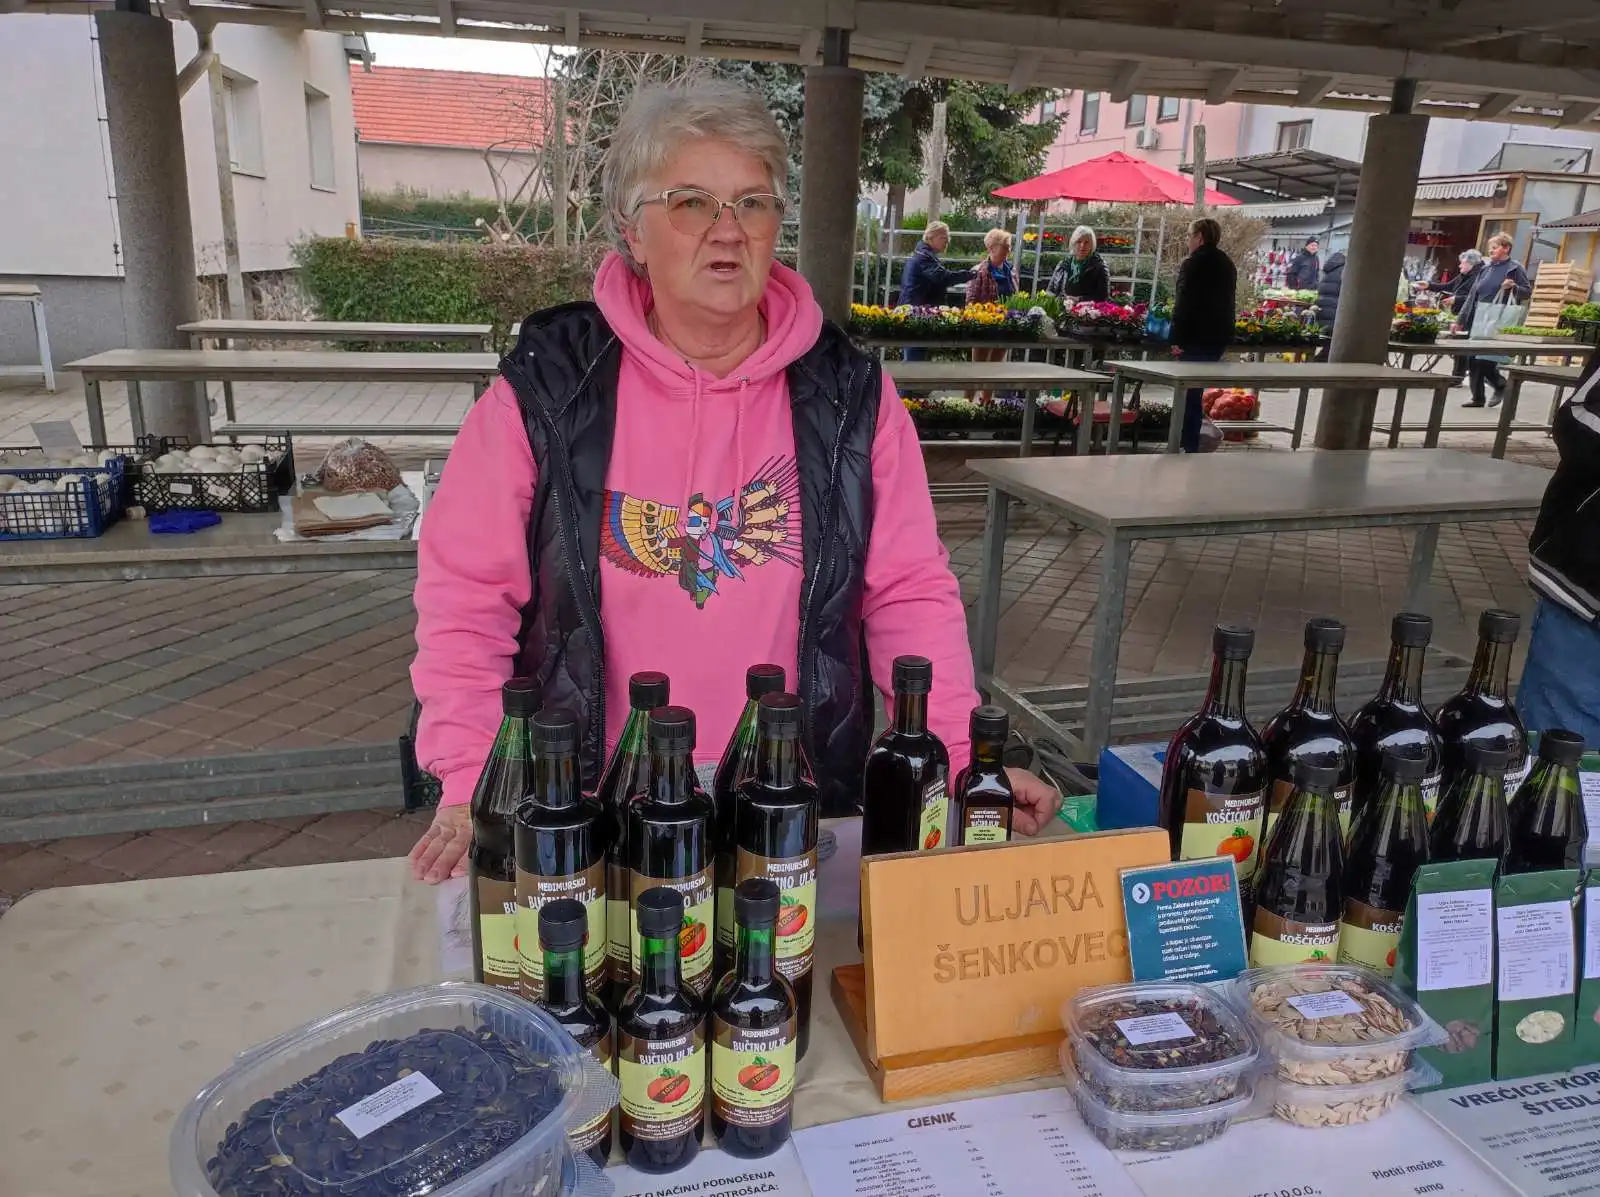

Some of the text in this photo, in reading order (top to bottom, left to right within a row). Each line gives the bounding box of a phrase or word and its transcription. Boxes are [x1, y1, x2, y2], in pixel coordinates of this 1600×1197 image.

[1152, 873, 1230, 901] POZOR!
[954, 871, 1104, 926] ULJARA
[1280, 933, 1331, 946] KOŠČIČNO
[639, 1051, 674, 1065] BUČINO
[1448, 1069, 1600, 1108] VREĆICE KOR
[1522, 1089, 1600, 1116] ŠTEDL
[907, 1112, 957, 1129] CJENIK
[1406, 1158, 1445, 1173] možete
[656, 1183, 700, 1197] NAČINU
[702, 1170, 776, 1189] PODNOŠENJA
[1413, 1182, 1444, 1195] samo
